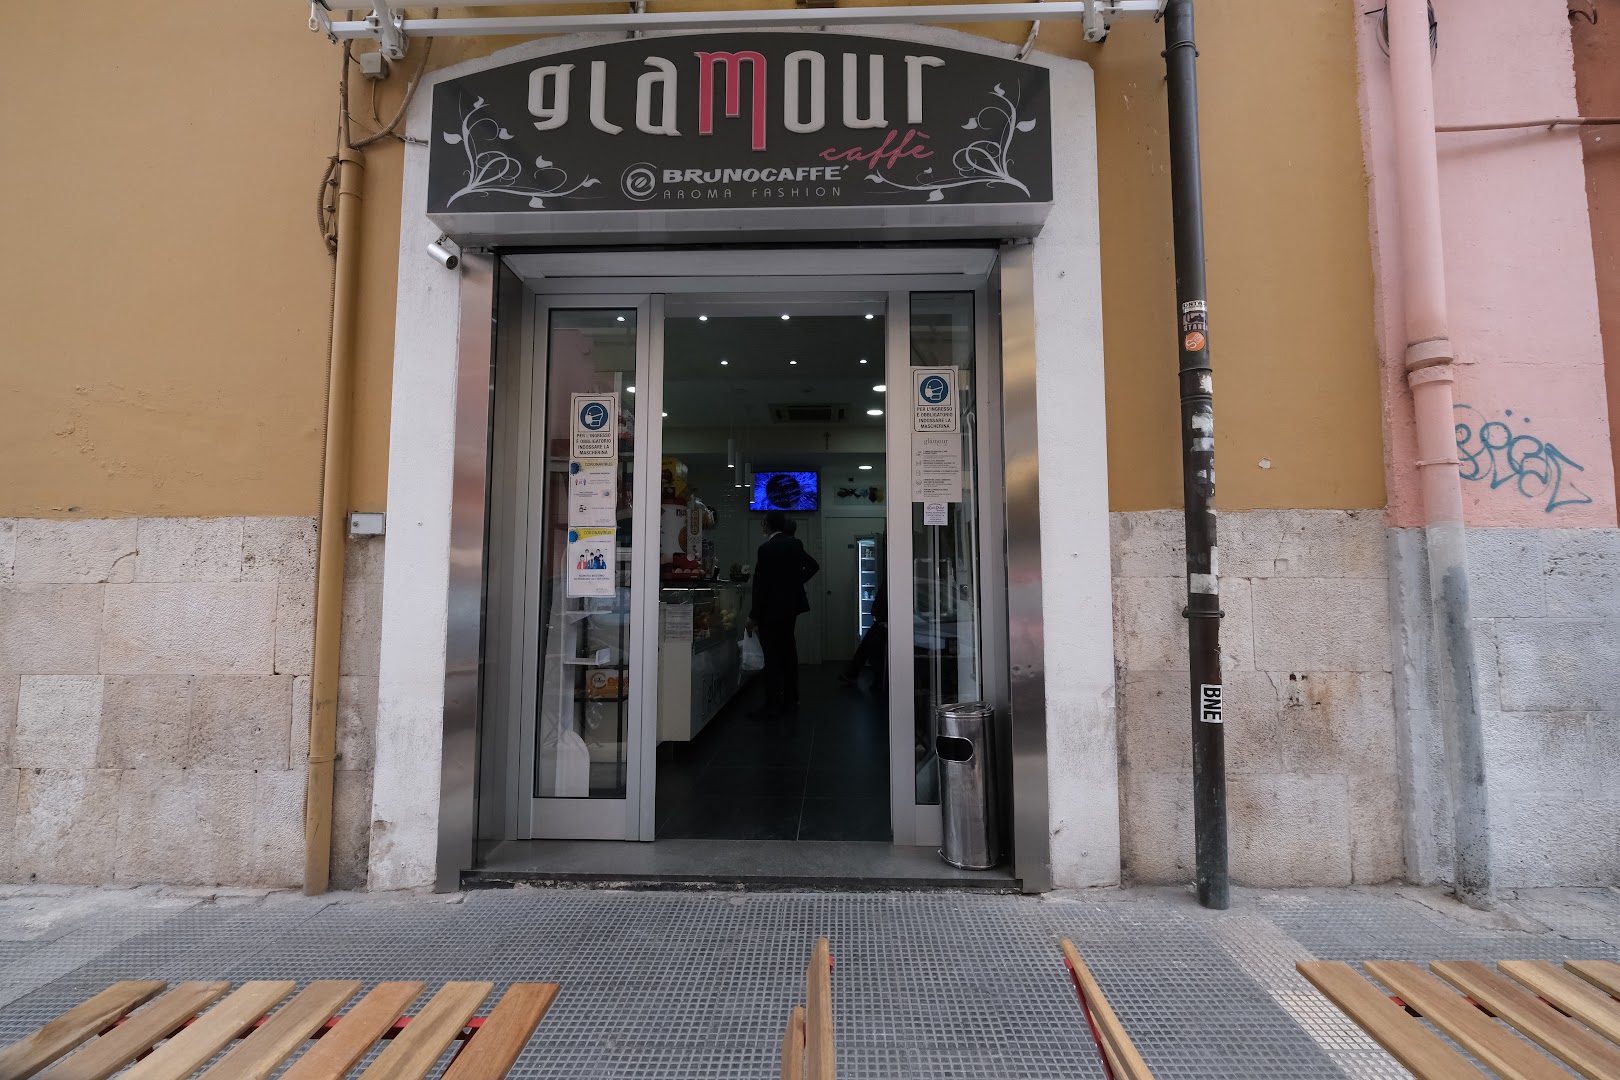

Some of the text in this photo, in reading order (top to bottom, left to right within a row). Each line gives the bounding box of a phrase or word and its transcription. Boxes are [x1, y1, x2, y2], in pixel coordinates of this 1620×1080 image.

[527, 50, 946, 152] glamour
[819, 129, 935, 169] caffè
[663, 187, 841, 200] AROMA FASHION
[1203, 687, 1222, 721] BNE
